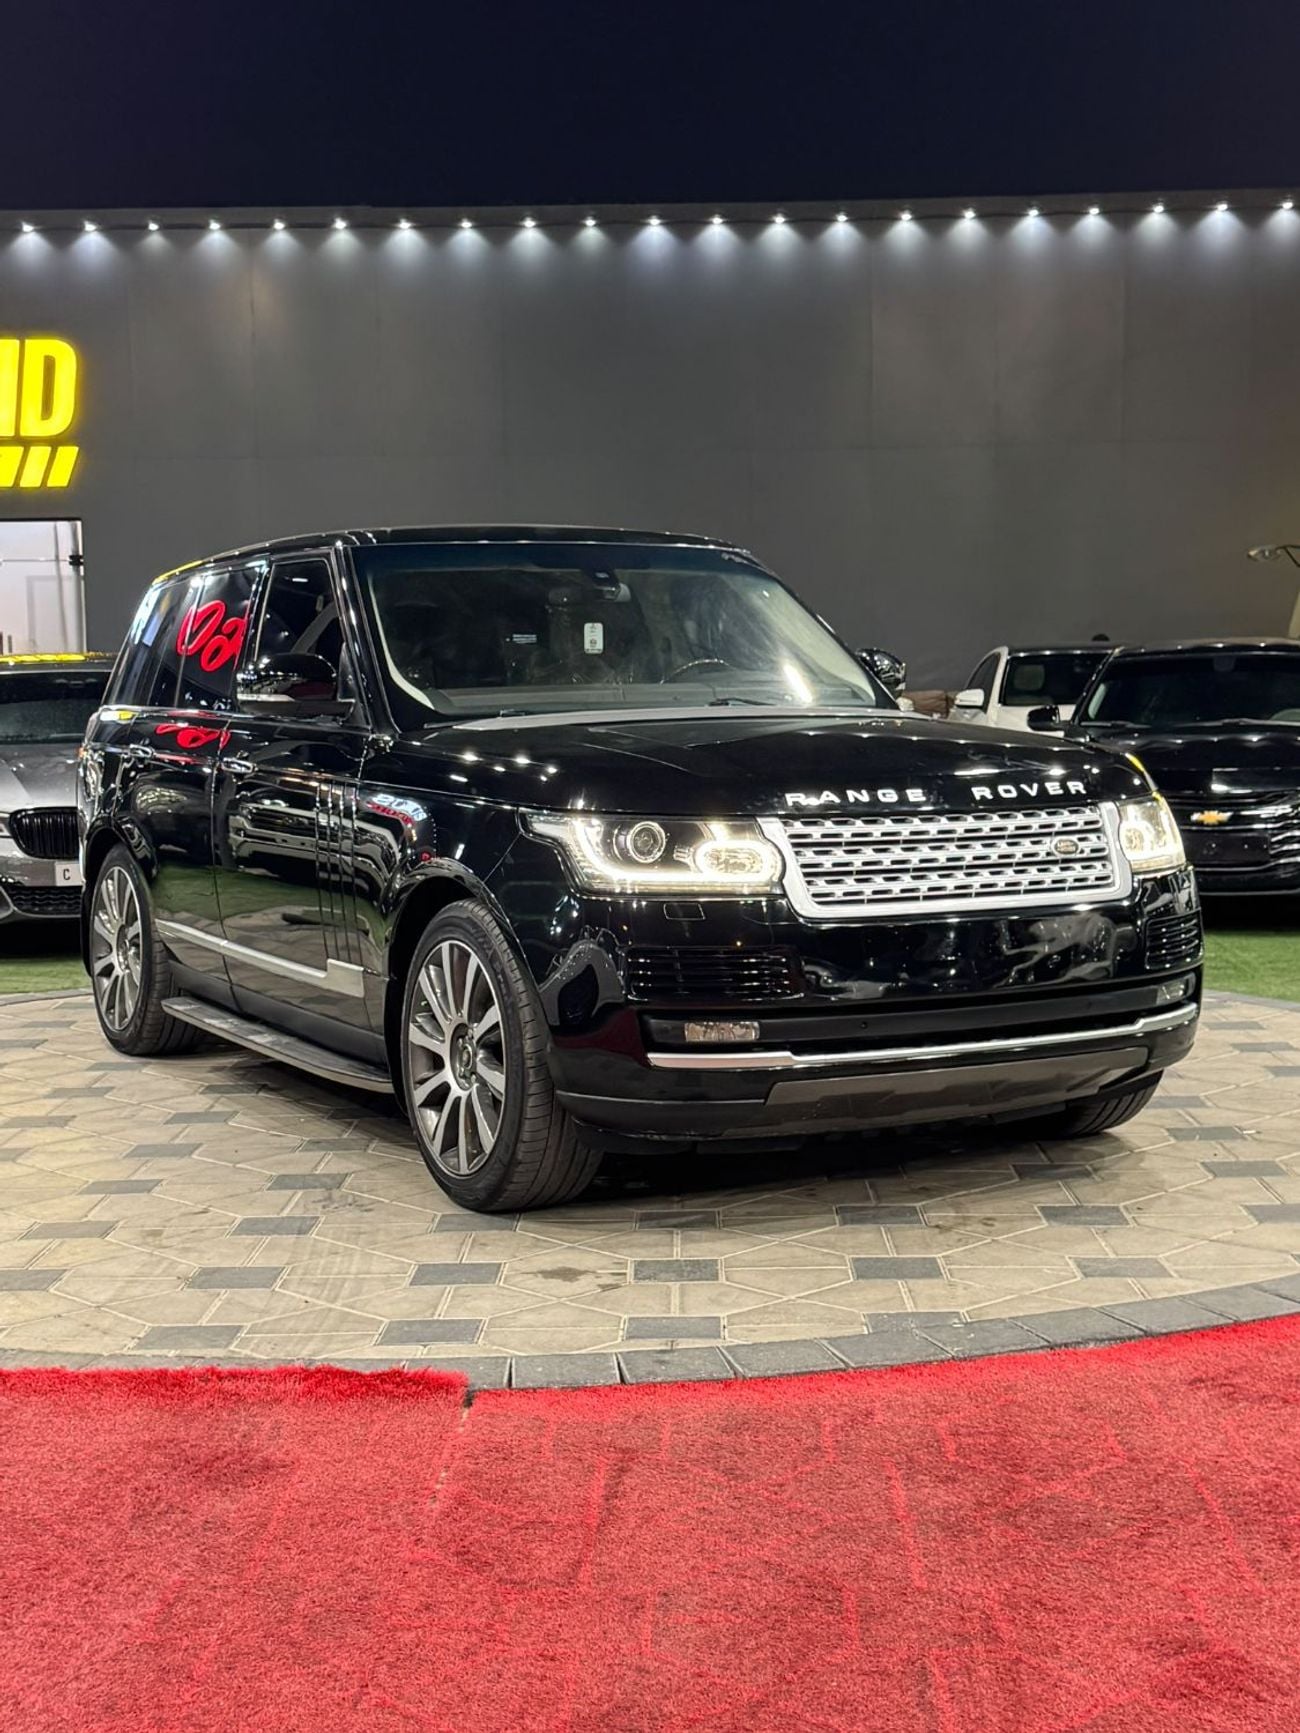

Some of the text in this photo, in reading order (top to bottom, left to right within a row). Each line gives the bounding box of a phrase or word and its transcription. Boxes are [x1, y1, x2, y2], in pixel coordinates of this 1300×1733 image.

[784, 781, 1087, 807] RANGE ROVER
[62, 868, 71, 881] C
